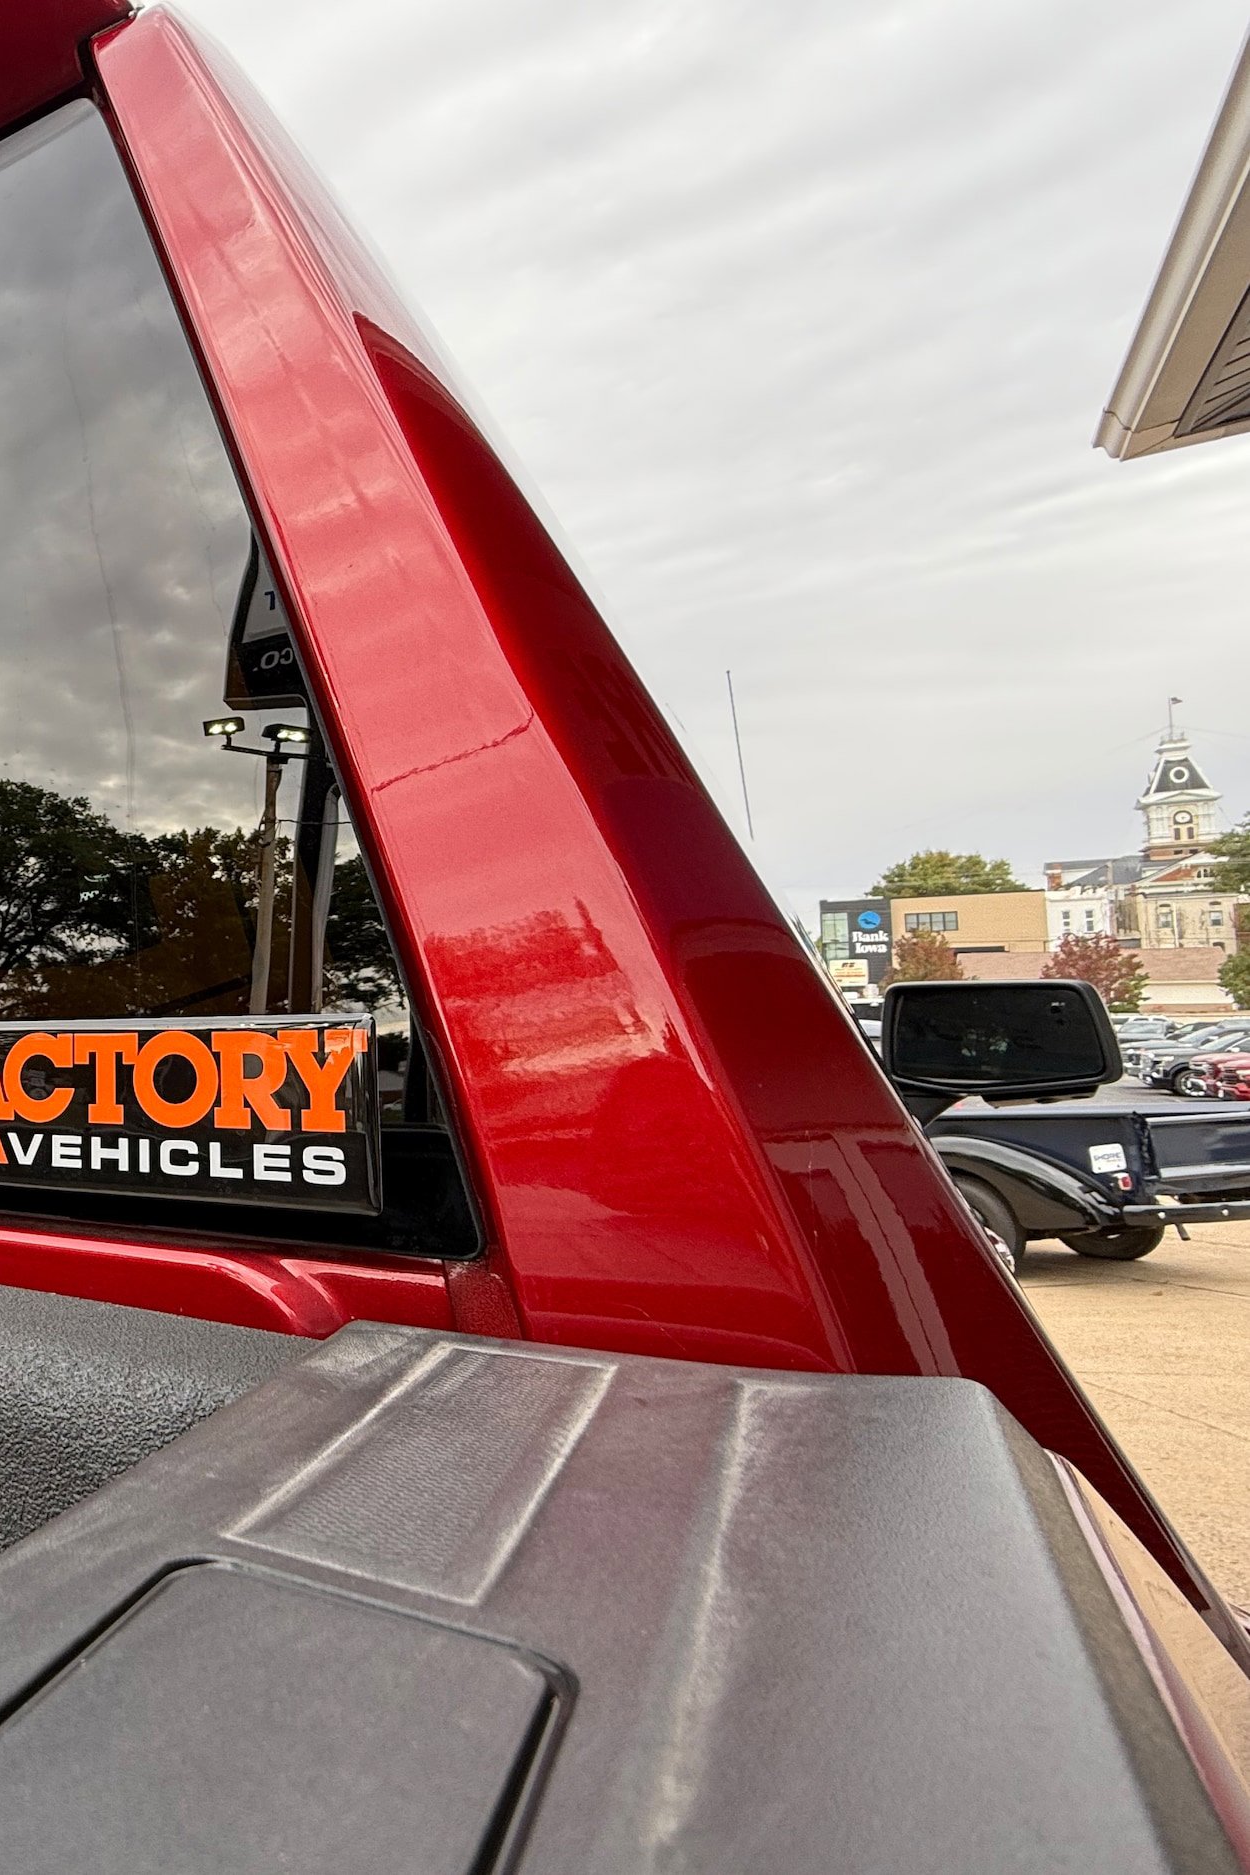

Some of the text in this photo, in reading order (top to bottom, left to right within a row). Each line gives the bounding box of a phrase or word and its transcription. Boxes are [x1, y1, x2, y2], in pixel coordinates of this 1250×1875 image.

[852, 930, 889, 942] Bank
[855, 943, 888, 953] Iowa
[8, 1132, 347, 1185] VEHICLES
